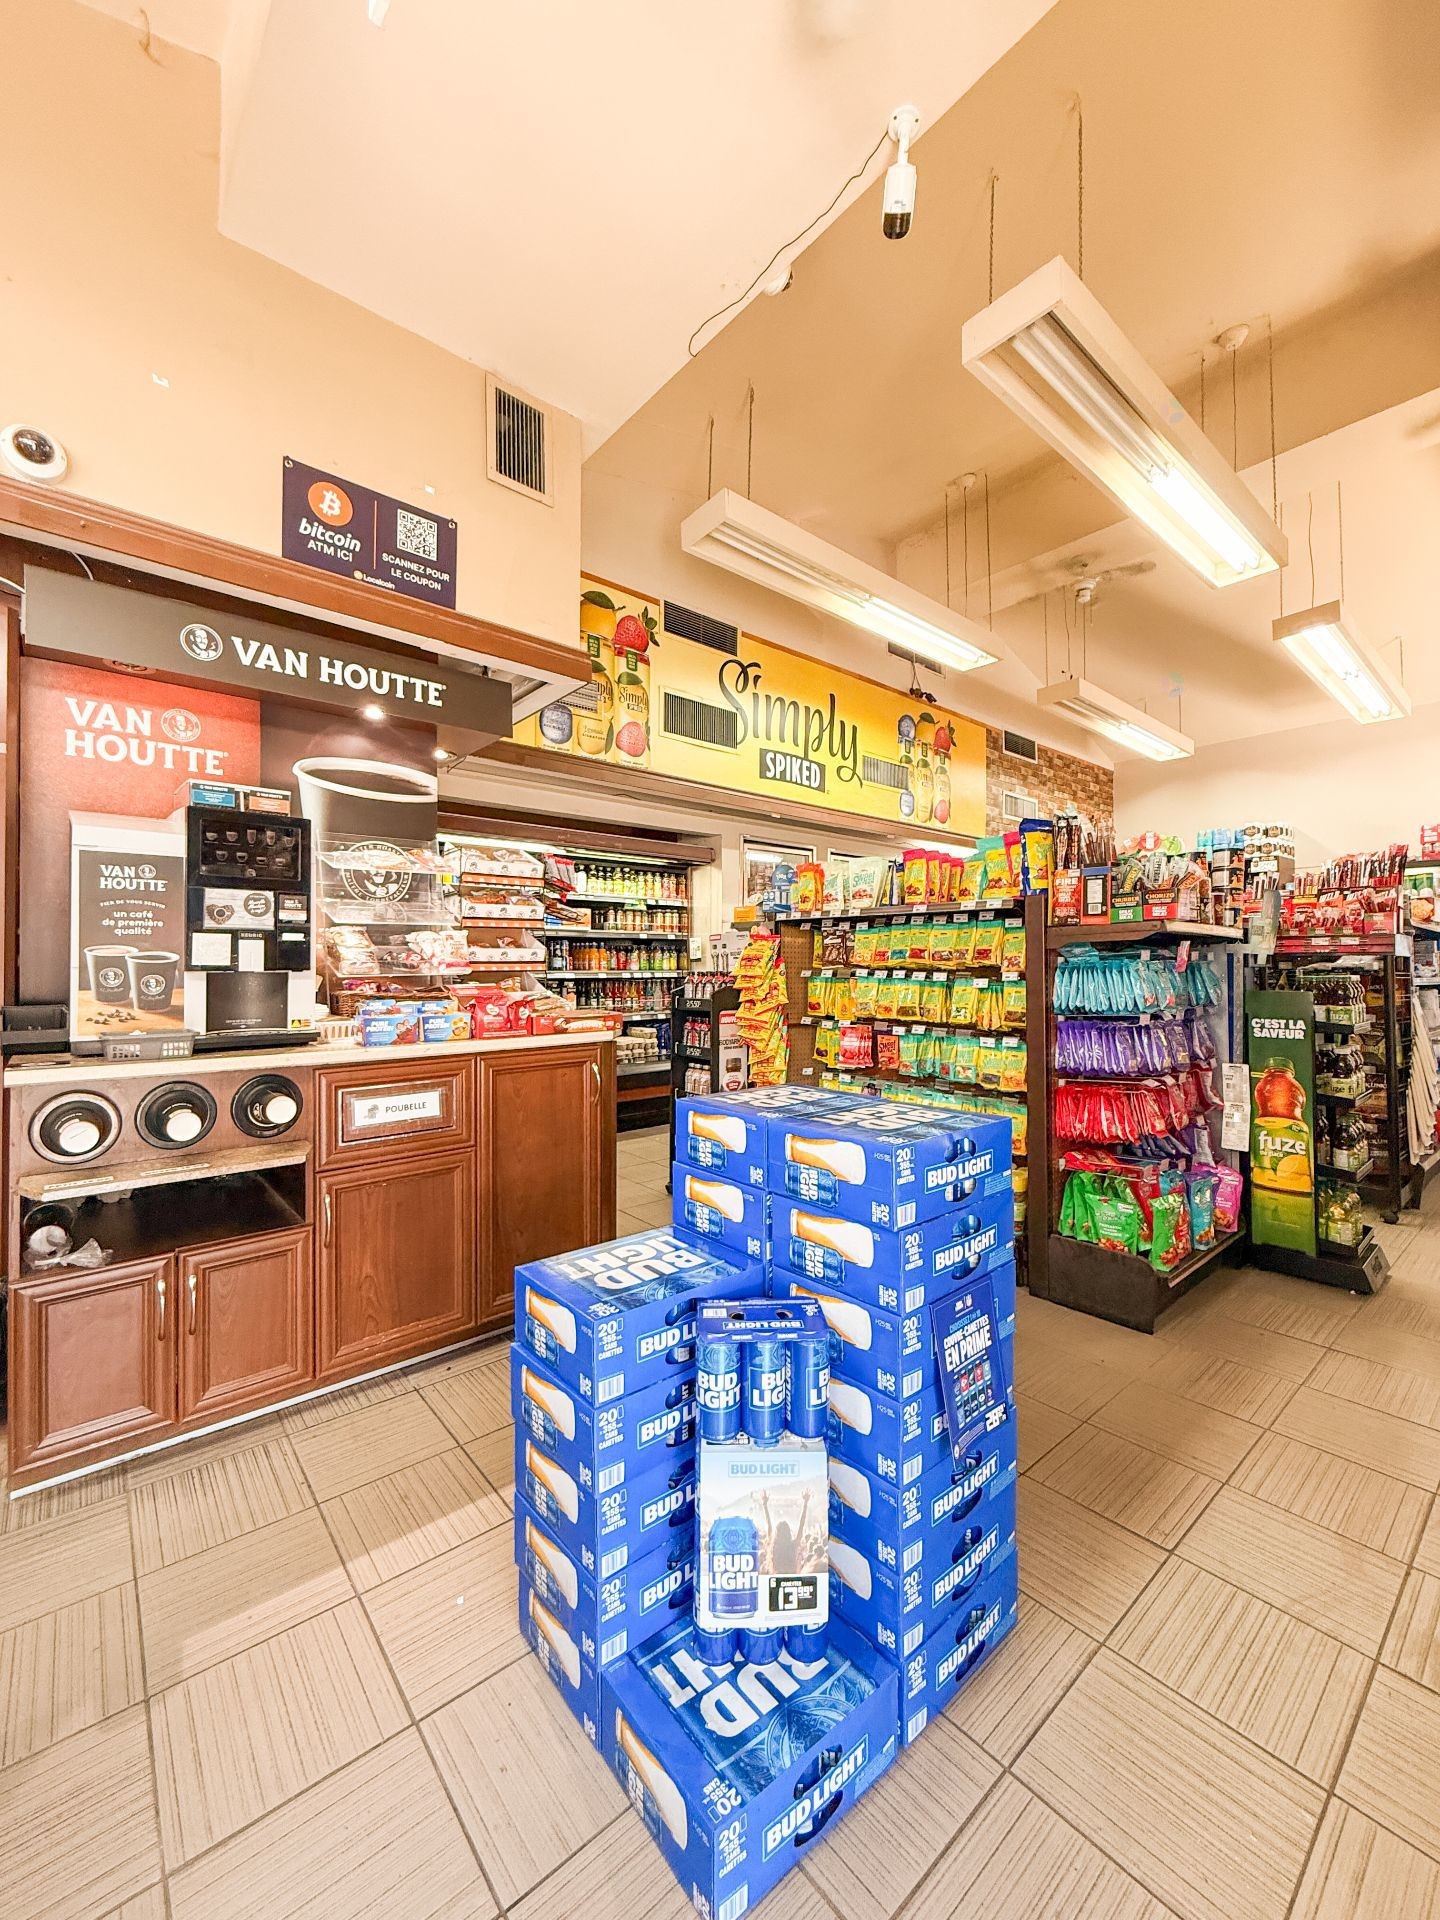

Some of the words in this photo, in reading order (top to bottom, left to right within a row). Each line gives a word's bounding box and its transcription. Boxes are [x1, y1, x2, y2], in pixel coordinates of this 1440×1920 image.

[299, 518, 361, 552] bitcoin
[307, 540, 334, 556] ATM
[338, 548, 353, 562] ICI
[382, 553, 425, 573] SCANNEZ
[426, 567, 450, 582] POUR
[391, 568, 401, 577] LE
[403, 572, 441, 591] COUPON
[231, 636, 308, 679] VAN
[319, 656, 444, 707] HOUTTE
[65, 697, 152, 735] VAN
[719, 659, 863, 788] Simply
[65, 729, 225, 775] HOUTTE
[765, 752, 821, 788] SPIKED
[100, 864, 136, 878] VAN
[100, 877, 168, 891] HOUTTE
[102, 918, 115, 926] de
[117, 918, 164, 928] première
[130, 909, 153, 918] café
[114, 927, 152, 936] qualité
[1251, 1018, 1286, 1029] C'EST
[1288, 1019, 1306, 1030] LA
[1330, 1012, 1349, 1020] fuze
[1253, 1028, 1305, 1039] SAVEUR
[385, 1101, 428, 1114] POUBELLE
[813, 1102, 929, 1126] LIGHT
[857, 1109, 952, 1131] BUD
[1258, 1131, 1307, 1155] fuze
[896, 1148, 910, 1162] 20
[927, 1165, 957, 1189] BUD
[957, 1154, 993, 1184] LIGHT
[881, 1204, 889, 1220] 20
[905, 1234, 919, 1249] 20
[934, 1247, 963, 1271] BUD
[964, 1228, 996, 1261] LIGHT
[558, 1235, 689, 1280] LIGHT
[594, 1249, 707, 1290] BUD
[888, 1286, 897, 1307] 20
[598, 1320, 618, 1336] 20
[726, 1321, 768, 1329] LIGHT
[903, 1317, 917, 1333] 20
[943, 1314, 989, 1349] COUVRE-CANETTES
[603, 1341, 618, 1351] CANS
[640, 1327, 681, 1357] BUD
[945, 1343, 960, 1372] EN
[960, 1324, 992, 1362] PRIME
[598, 1347, 623, 1361] CANETTES
[698, 1370, 738, 1391] BUD
[761, 1366, 785, 1389] BU
[886, 1370, 896, 1389] 20
[752, 1383, 785, 1406] LIG
[599, 1407, 618, 1422] 20
[903, 1402, 918, 1418] 20
[641, 1410, 681, 1442] BUD
[933, 1413, 949, 1437] BU
[730, 1463, 759, 1475] BUD
[760, 1463, 797, 1475] LIGHT
[887, 1456, 896, 1476] 20
[903, 1487, 917, 1505] 20
[933, 1488, 963, 1520] BUD
[963, 1457, 998, 1497] LIGHT
[601, 1492, 621, 1512] 20
[644, 1490, 683, 1526] BUD
[713, 1555, 755, 1572] BUD
[935, 1567, 963, 1598] BUD
[963, 1529, 998, 1577] LIGHT
[601, 1578, 620, 1597] 20
[643, 1572, 682, 1609] BUD
[709, 1571, 759, 1590] LIGHT
[770, 1578, 777, 1588] 6
[903, 1572, 918, 1590] 20
[938, 1645, 968, 1683] BUD
[967, 1606, 1000, 1648] LIGHT
[907, 1655, 922, 1674] 20
[703, 1777, 721, 1795] CANS
[716, 1787, 742, 1815] 20
[766, 1800, 812, 1852] BUD
[812, 1743, 867, 1812] LIGHT
[719, 1820, 740, 1848] 20
[719, 1852, 747, 1879] CANETTES
[725, 1847, 741, 1864] CANS
